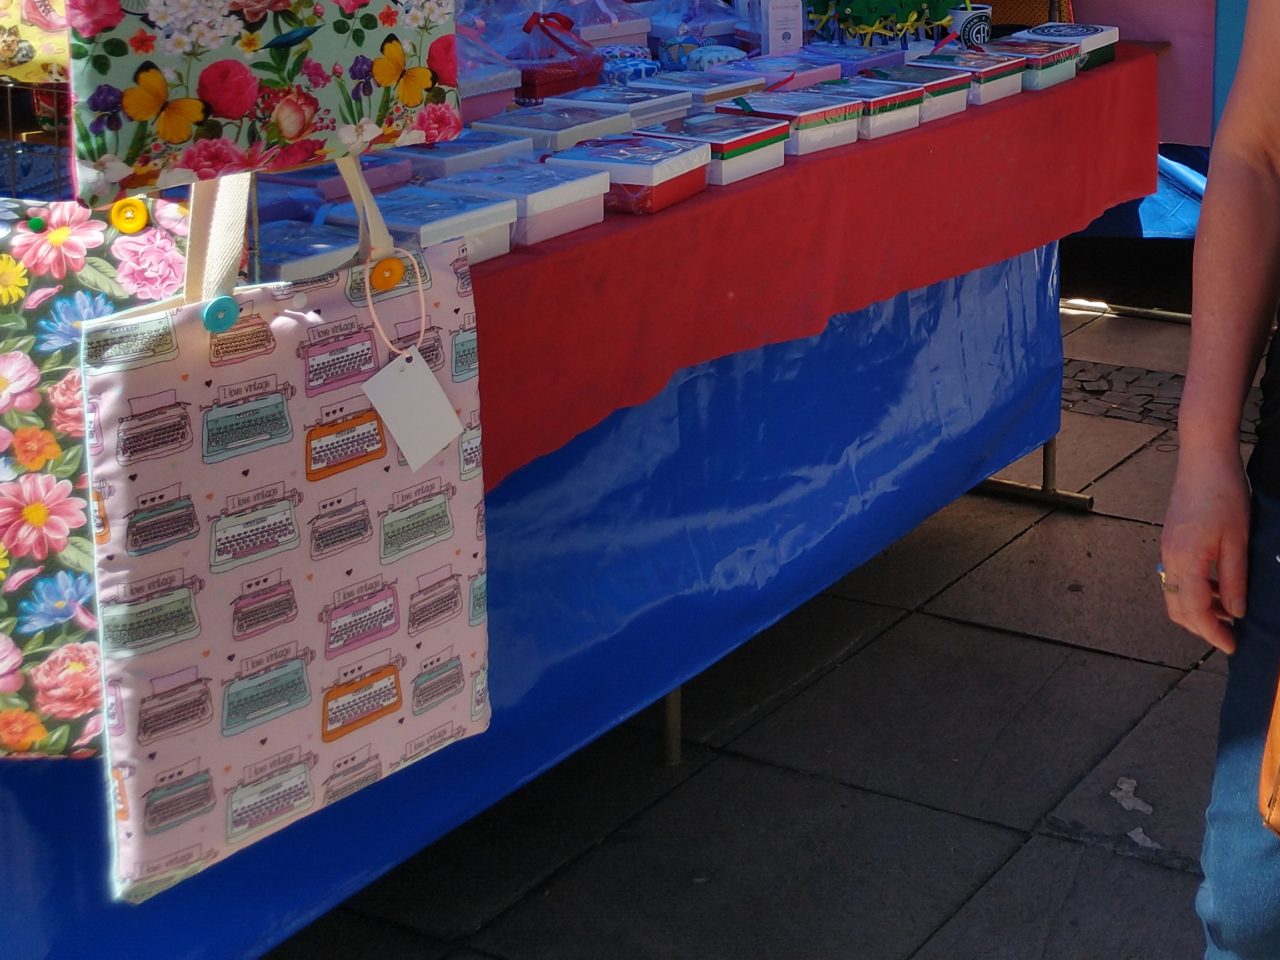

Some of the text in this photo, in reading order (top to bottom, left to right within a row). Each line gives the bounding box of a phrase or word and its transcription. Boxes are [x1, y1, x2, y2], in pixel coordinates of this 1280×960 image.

[318, 328, 330, 337] love
[331, 320, 356, 336] vintage
[229, 387, 243, 397] love
[244, 380, 270, 394] vintage
[238, 497, 250, 506] love
[252, 488, 278, 502] vintage
[402, 492, 413, 501] love
[414, 483, 436, 498] vintage
[344, 590, 356, 601] love
[358, 580, 380, 597] vintage
[251, 658, 264, 669] love
[266, 648, 291, 664] vintage
